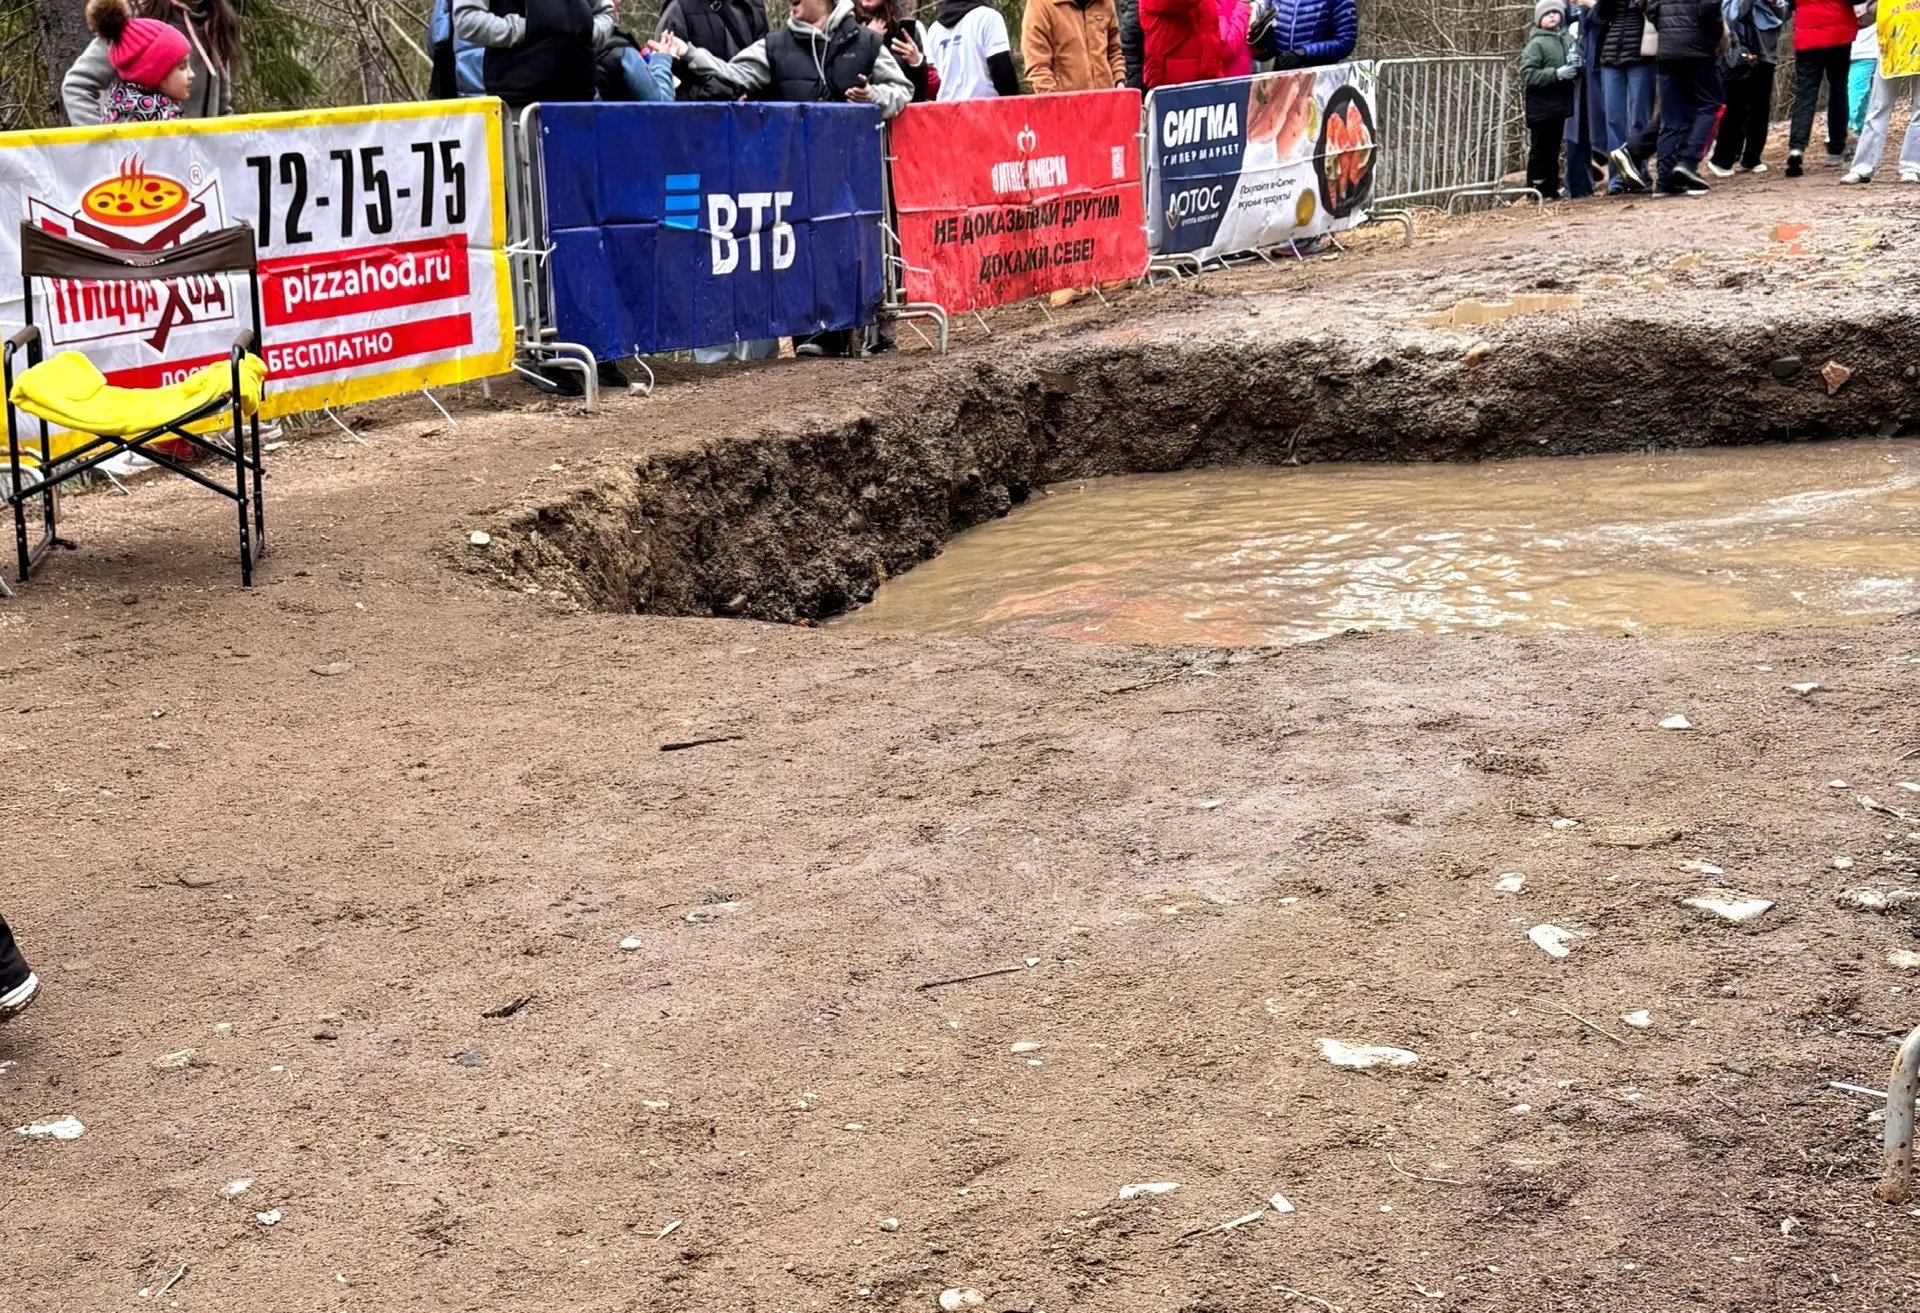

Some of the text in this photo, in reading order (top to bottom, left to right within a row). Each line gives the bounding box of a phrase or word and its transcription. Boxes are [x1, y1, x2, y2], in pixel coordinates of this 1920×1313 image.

[1163, 102, 1238, 148] СИГМА
[246, 139, 466, 248] 72-75-75
[1169, 184, 1223, 217] ЛОТОС
[707, 190, 796, 275] ВТБ
[934, 194, 1120, 246] НЕ ДОКАЗЫВАЙ ДРУГИМ
[283, 252, 451, 314] pizzahod.ru
[978, 237, 1095, 285] ДОКАЖИ СЕБЕ!
[268, 332, 393, 373] БЕСПЛАТНО
